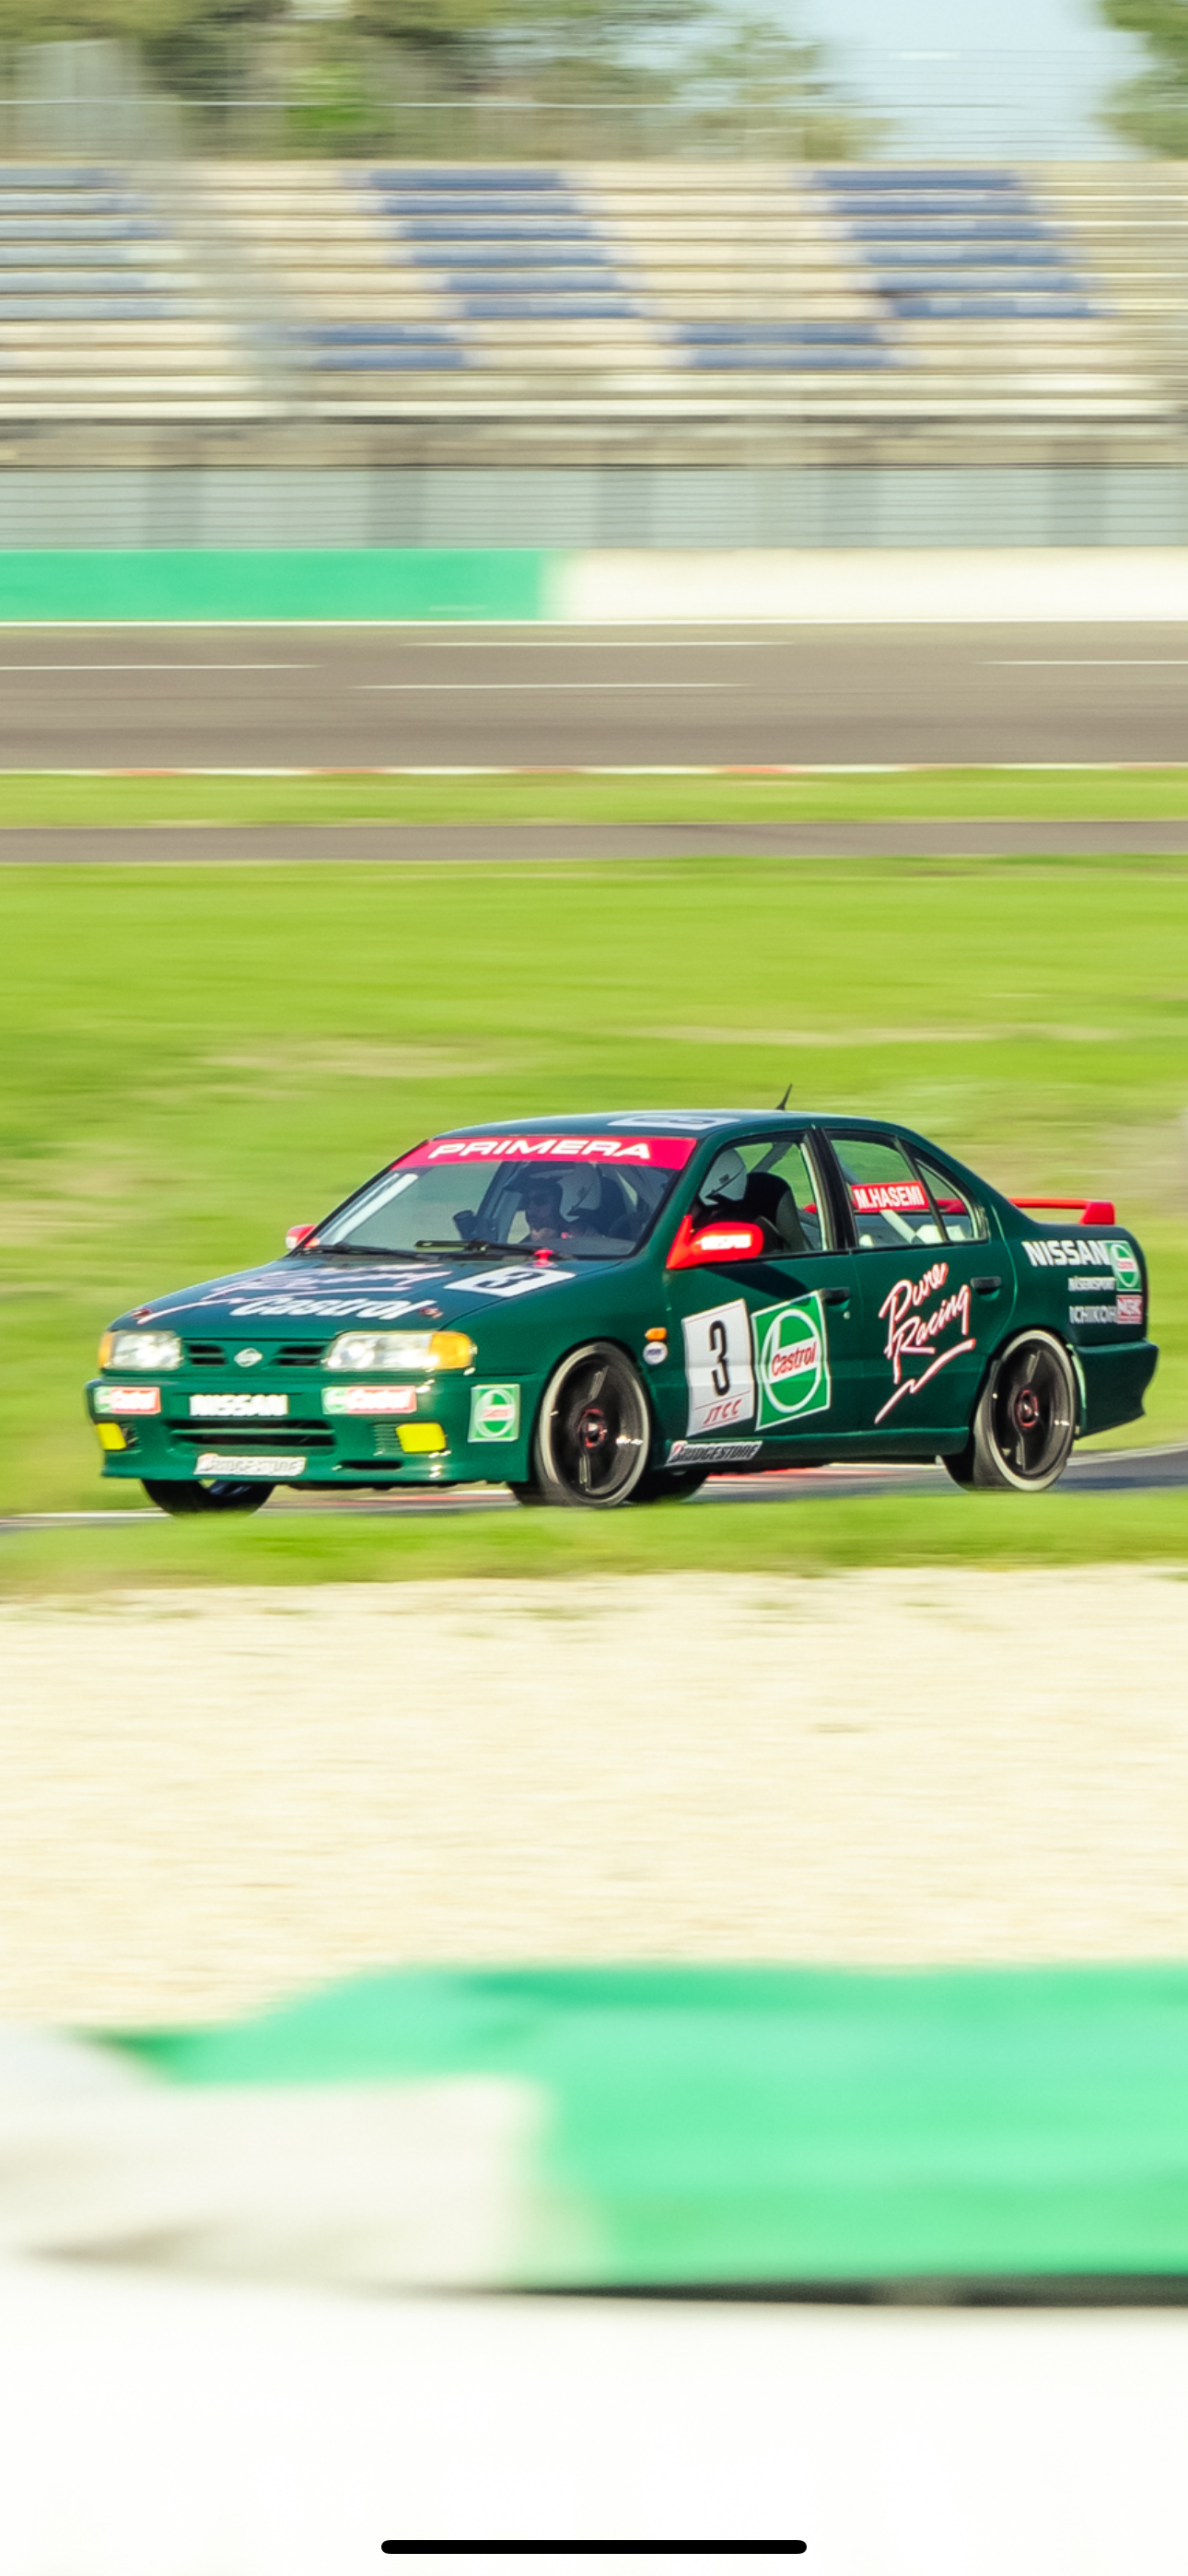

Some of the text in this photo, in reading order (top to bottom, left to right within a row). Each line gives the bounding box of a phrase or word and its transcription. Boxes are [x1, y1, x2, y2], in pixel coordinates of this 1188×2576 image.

[427, 1139, 651, 1160] PRIMERA
[853, 1184, 925, 1210] M.HASEMI
[1020, 1240, 1112, 1267] NISSAN
[474, 1270, 542, 1290] 3
[230, 1297, 438, 1320] Castrol
[878, 1262, 949, 1360] Pure
[884, 1284, 971, 1384] Racing
[709, 1319, 730, 1397] 3
[771, 1341, 817, 1376] Castrol
